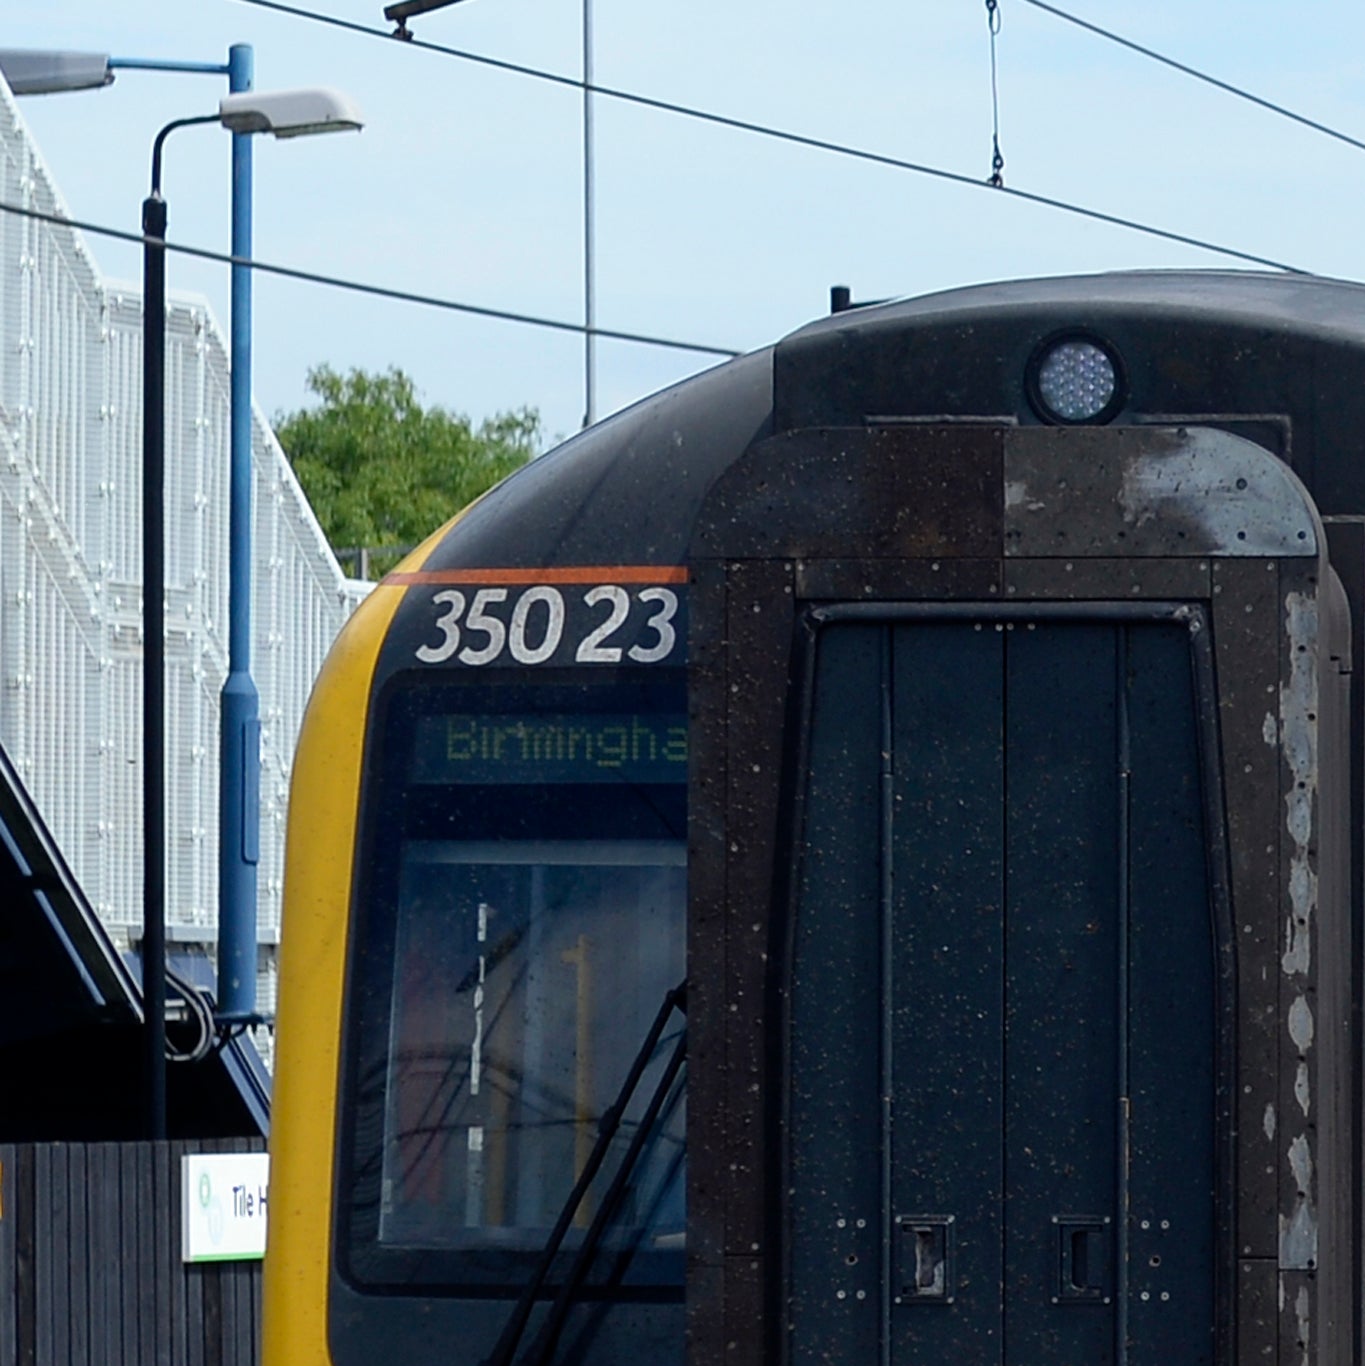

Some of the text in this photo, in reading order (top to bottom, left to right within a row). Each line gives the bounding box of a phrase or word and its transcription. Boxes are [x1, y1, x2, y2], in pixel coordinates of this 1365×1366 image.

[415, 585, 679, 665] 350 23
[447, 714, 688, 766] Birmingha
[232, 1185, 254, 1217] Tile
